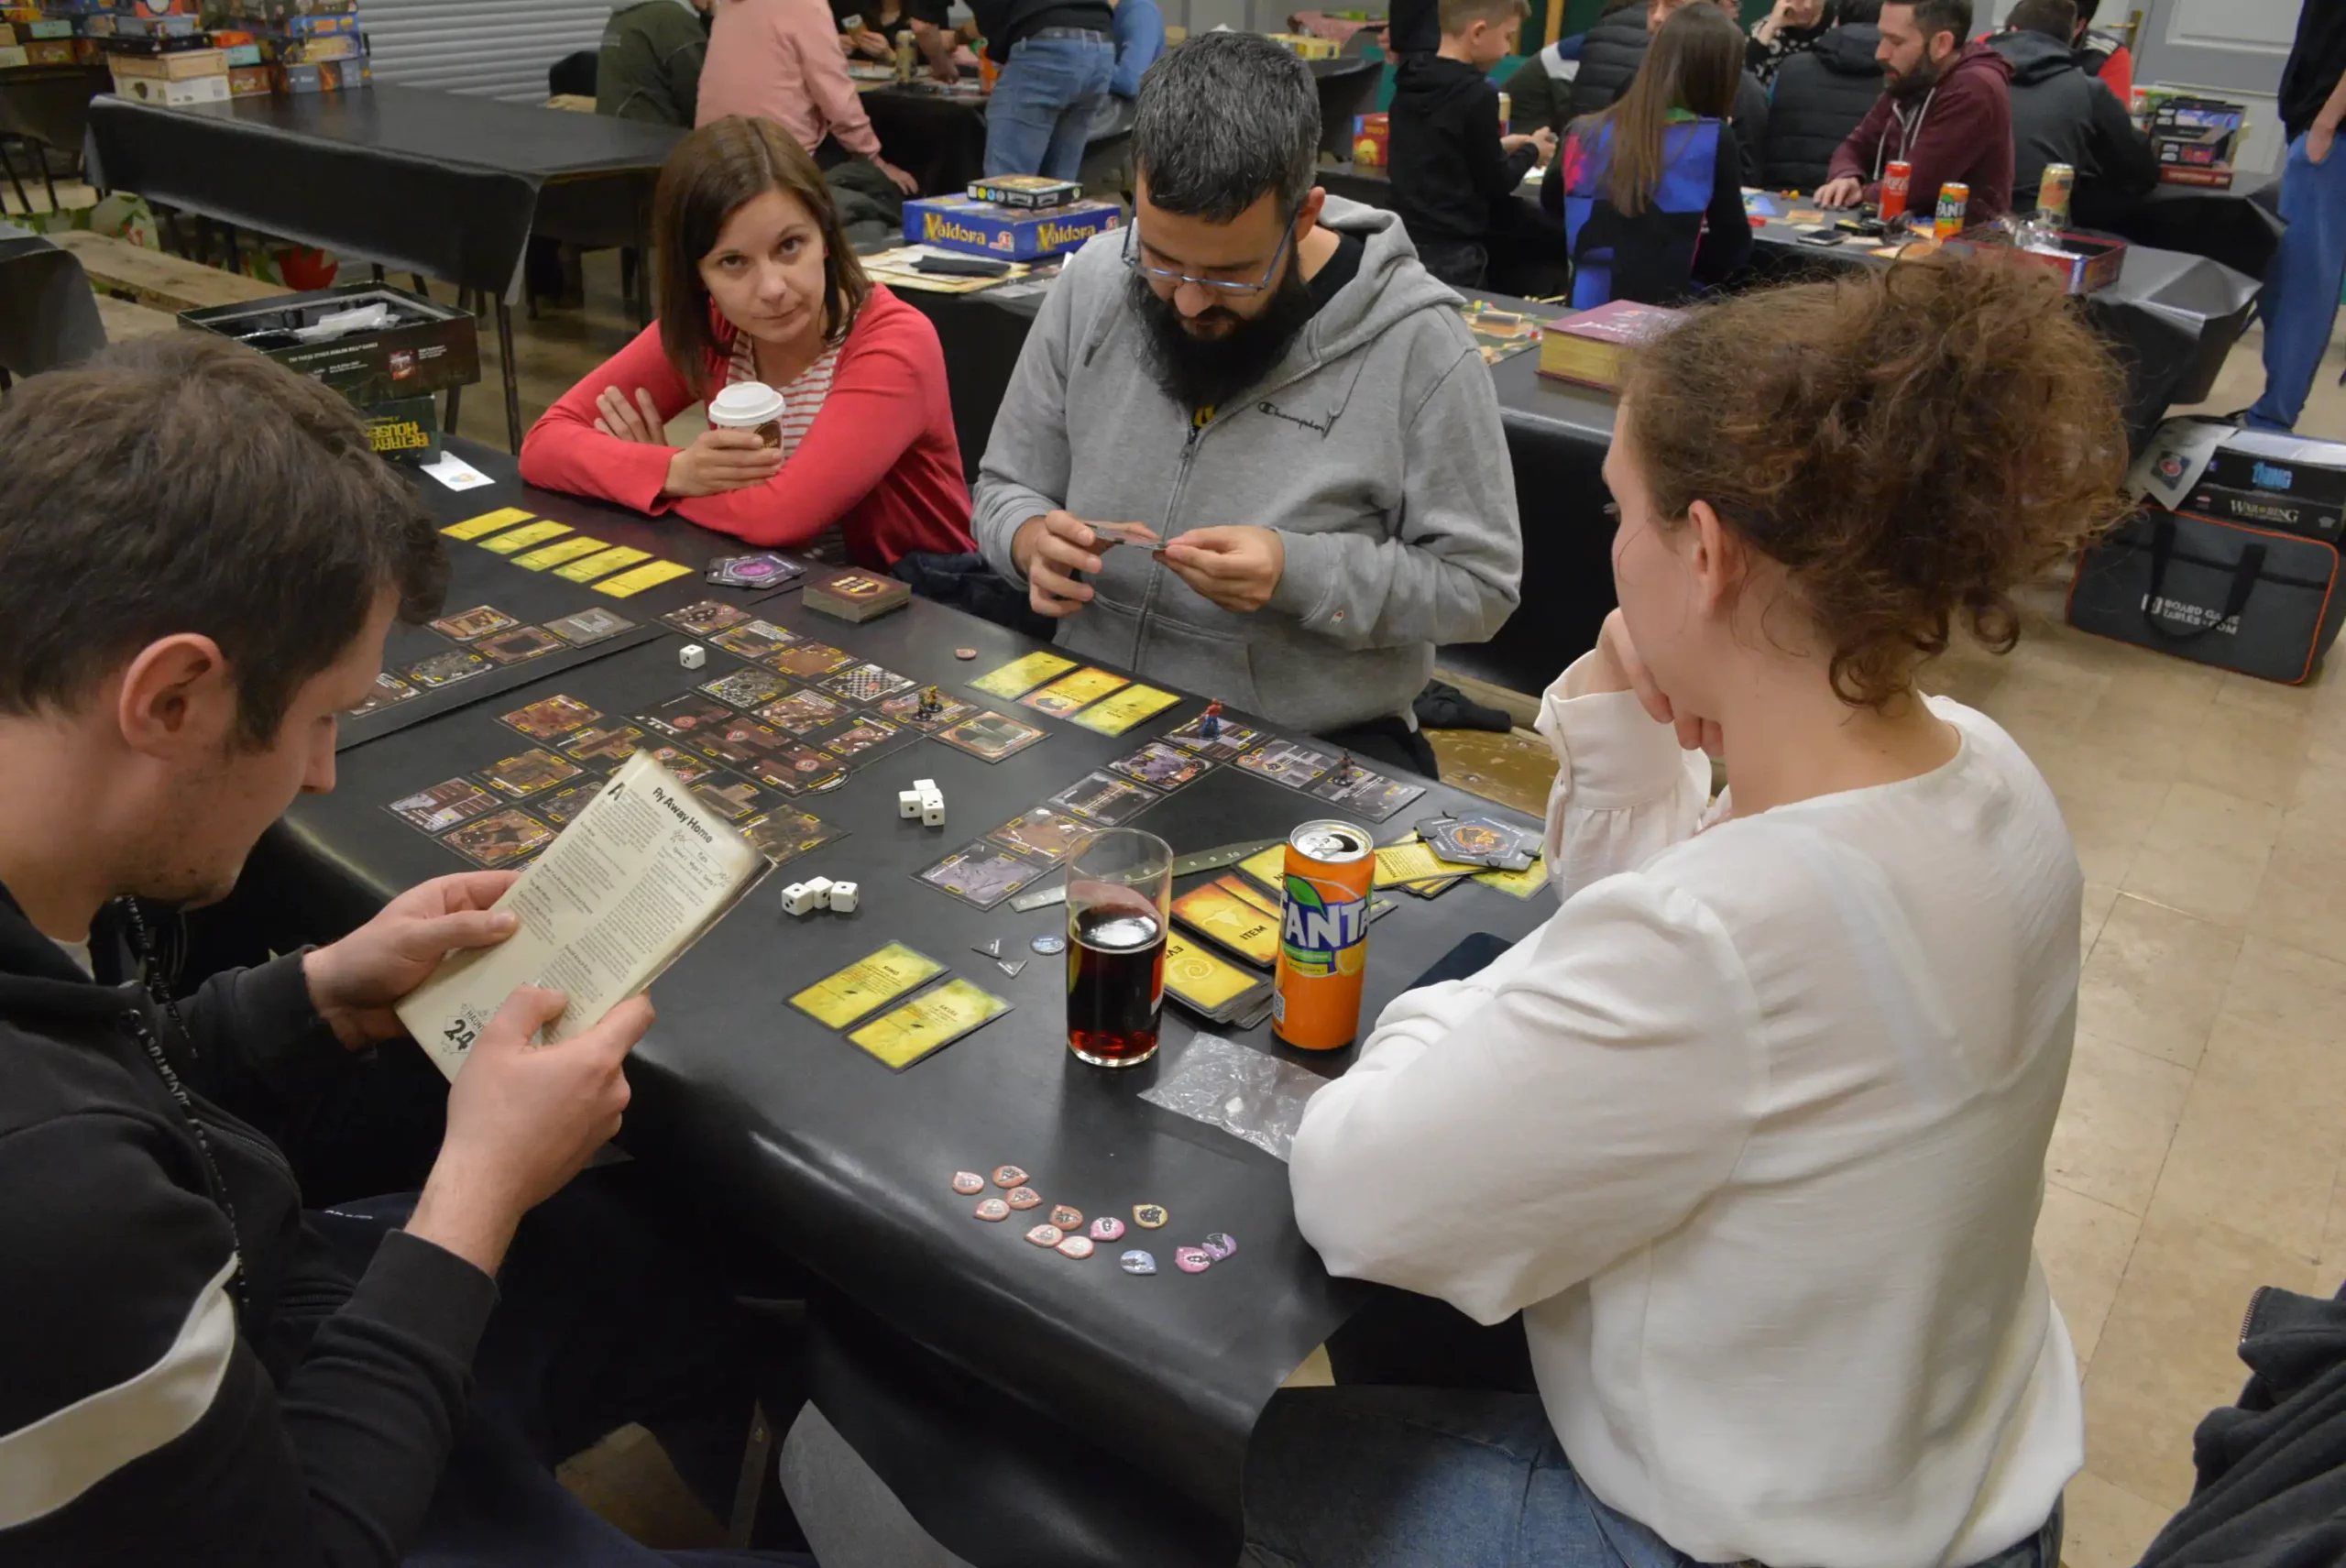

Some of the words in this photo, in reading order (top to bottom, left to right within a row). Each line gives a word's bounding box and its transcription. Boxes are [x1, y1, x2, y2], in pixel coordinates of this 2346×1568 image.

[924, 212, 986, 246] Valdora
[1036, 222, 1097, 252] Valdora
[370, 432, 431, 452] BETRAY
[2165, 599, 2203, 616] BOARD
[652, 787, 666, 802] Fly
[663, 798, 689, 824] Away
[686, 817, 713, 844] Home
[1239, 925, 1267, 941] ITEM
[444, 1018, 477, 1051] 24
